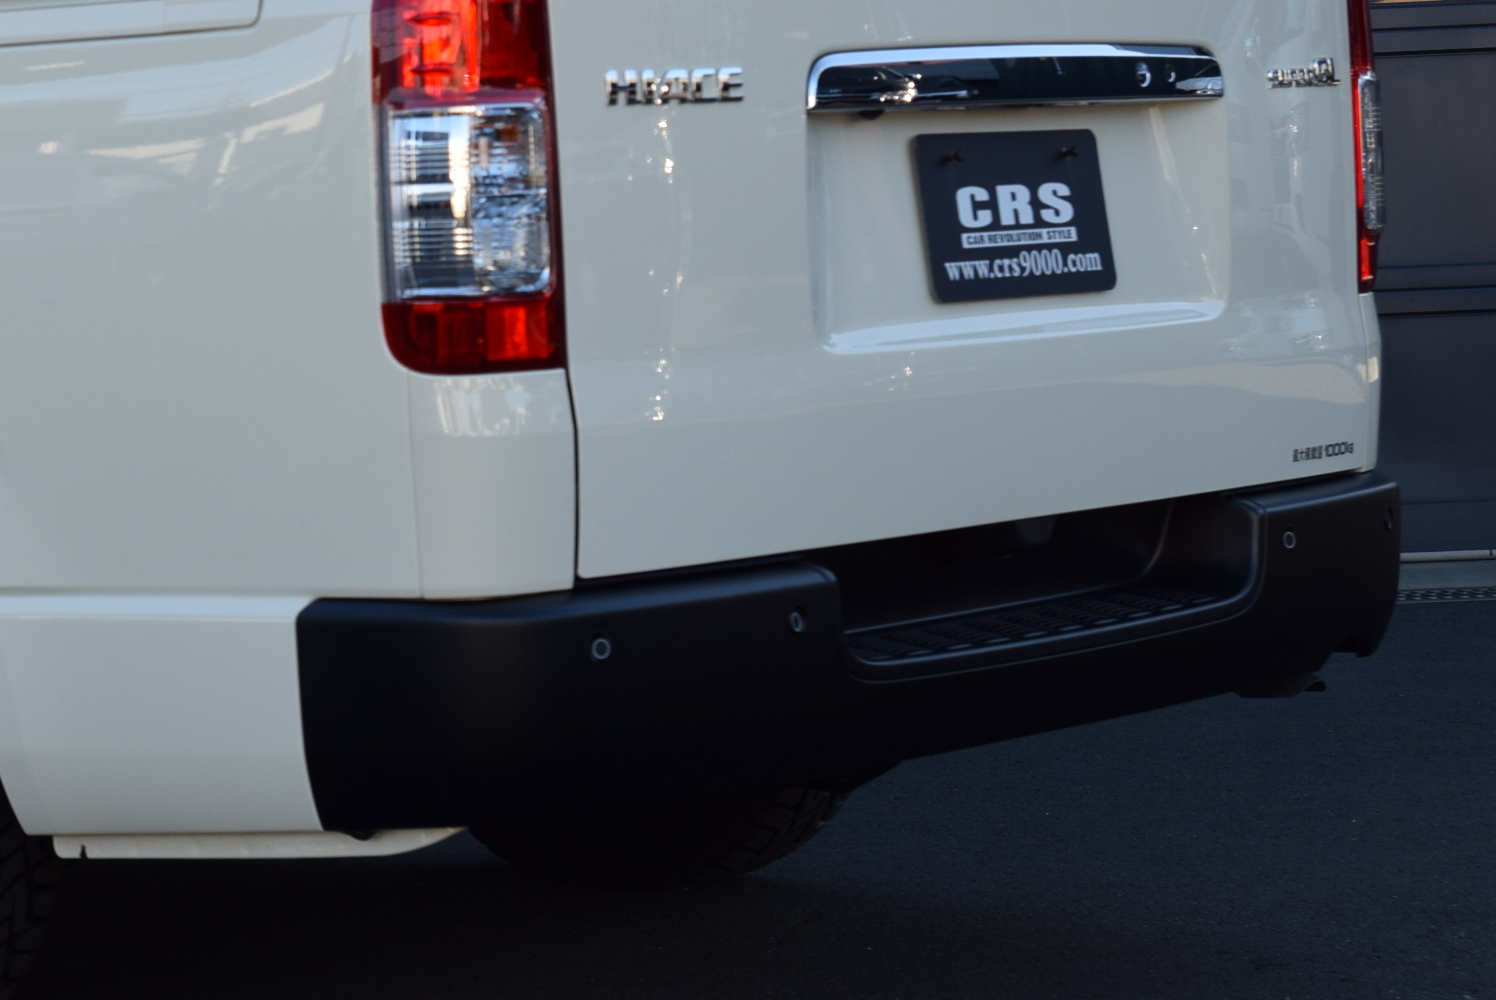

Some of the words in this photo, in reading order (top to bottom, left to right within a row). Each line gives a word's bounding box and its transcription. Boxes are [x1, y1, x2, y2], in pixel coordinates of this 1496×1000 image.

[605, 66, 744, 106] HIACE
[955, 182, 1075, 229] CRS
[966, 234, 986, 246] CAR
[988, 231, 1043, 244] REVOLUTION
[1045, 228, 1074, 241] STYLE
[944, 248, 1103, 281] www.crs9000.com
